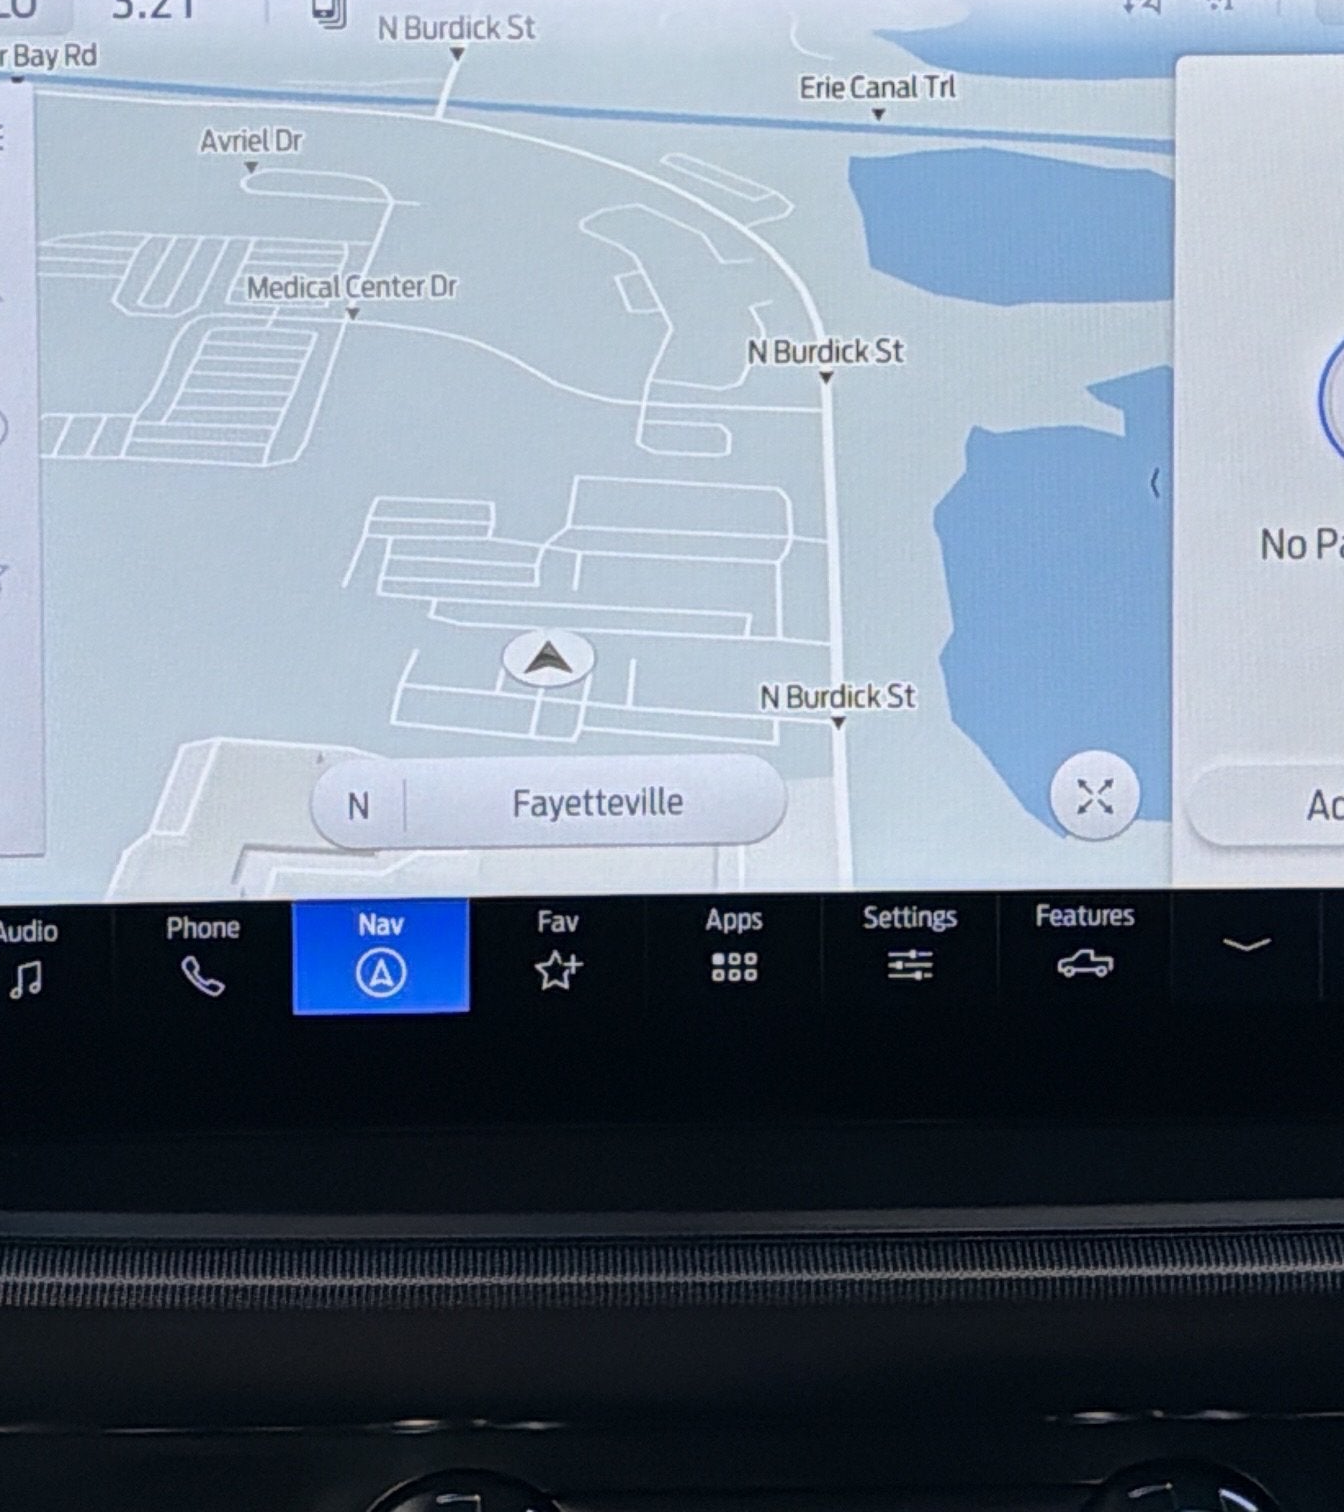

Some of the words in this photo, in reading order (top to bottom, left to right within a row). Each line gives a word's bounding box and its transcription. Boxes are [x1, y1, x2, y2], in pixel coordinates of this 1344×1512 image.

[378, 16, 397, 40] N
[404, 15, 501, 40] Burdick
[507, 14, 536, 40] St
[13, 44, 60, 72] Bay
[64, 42, 97, 67] Rd
[801, 76, 846, 99] Erie
[850, 75, 918, 99] Canal
[924, 74, 956, 98] Trl
[200, 128, 270, 153] Avriel
[275, 128, 302, 152] Dr
[248, 274, 340, 299] Medical
[346, 274, 426, 298] Center
[431, 274, 457, 297] Dr
[748, 339, 767, 364] N
[774, 338, 869, 364] Burdick
[875, 337, 904, 364] St
[1261, 527, 1307, 560] No
[761, 685, 779, 709] N
[787, 683, 881, 709] Burdick
[887, 683, 915, 709] St
[349, 791, 369, 820] N
[514, 786, 684, 823] Fayetteville
[166, 915, 241, 939] Phone
[359, 912, 404, 936] Nav
[538, 909, 579, 933] Fav
[705, 907, 763, 934] Apps
[863, 905, 958, 933] Settings
[1036, 903, 1135, 927] Features
